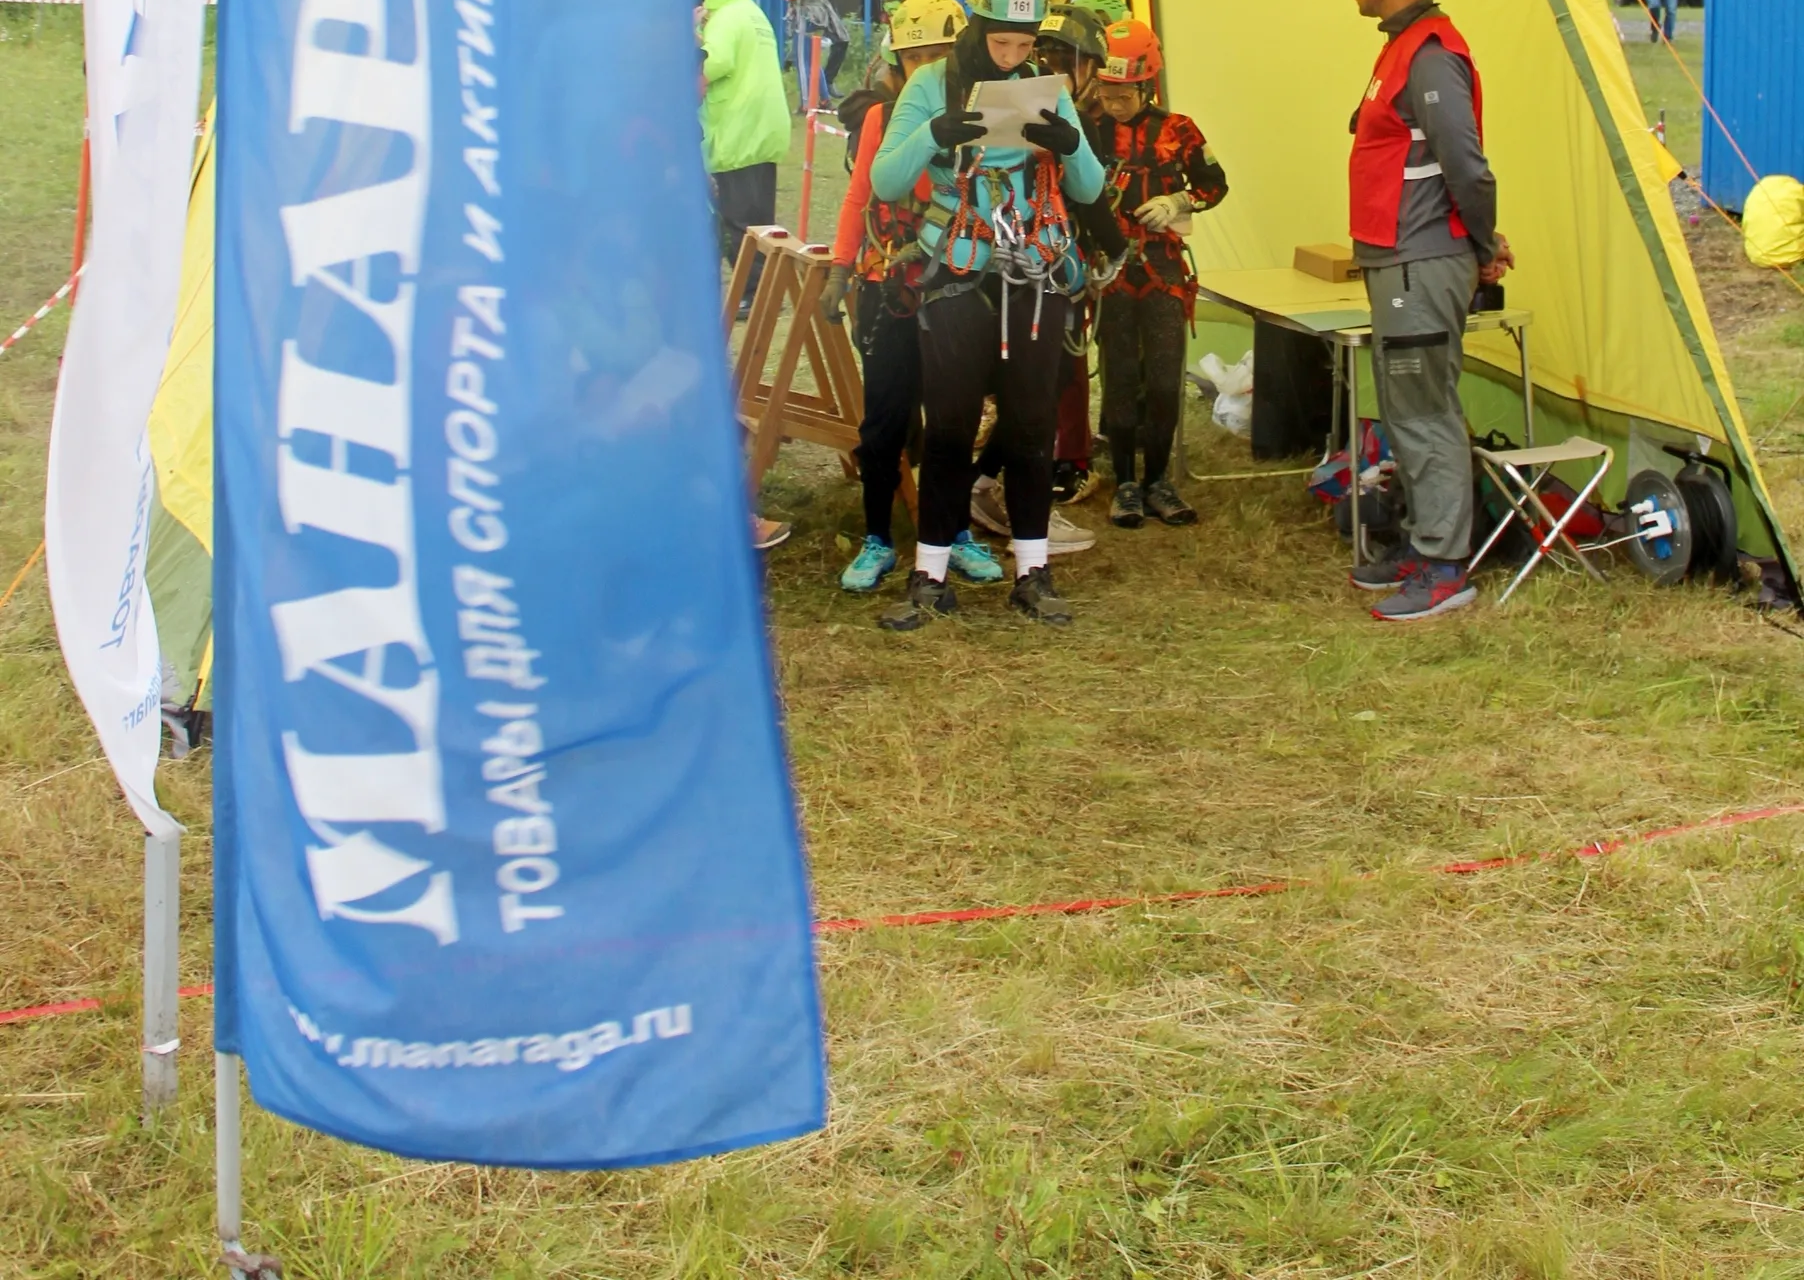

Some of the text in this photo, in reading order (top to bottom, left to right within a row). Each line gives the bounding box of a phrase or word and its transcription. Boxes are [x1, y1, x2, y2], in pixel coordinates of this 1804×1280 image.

[905, 29, 924, 41] 162
[1012, 0, 1031, 13] 161
[1108, 65, 1124, 76] 164
[462, 203, 506, 263] И
[444, 285, 510, 553] СПОРТА
[453, 564, 548, 689] ДЛЯ
[476, 701, 565, 933] ТОВАРЫ
